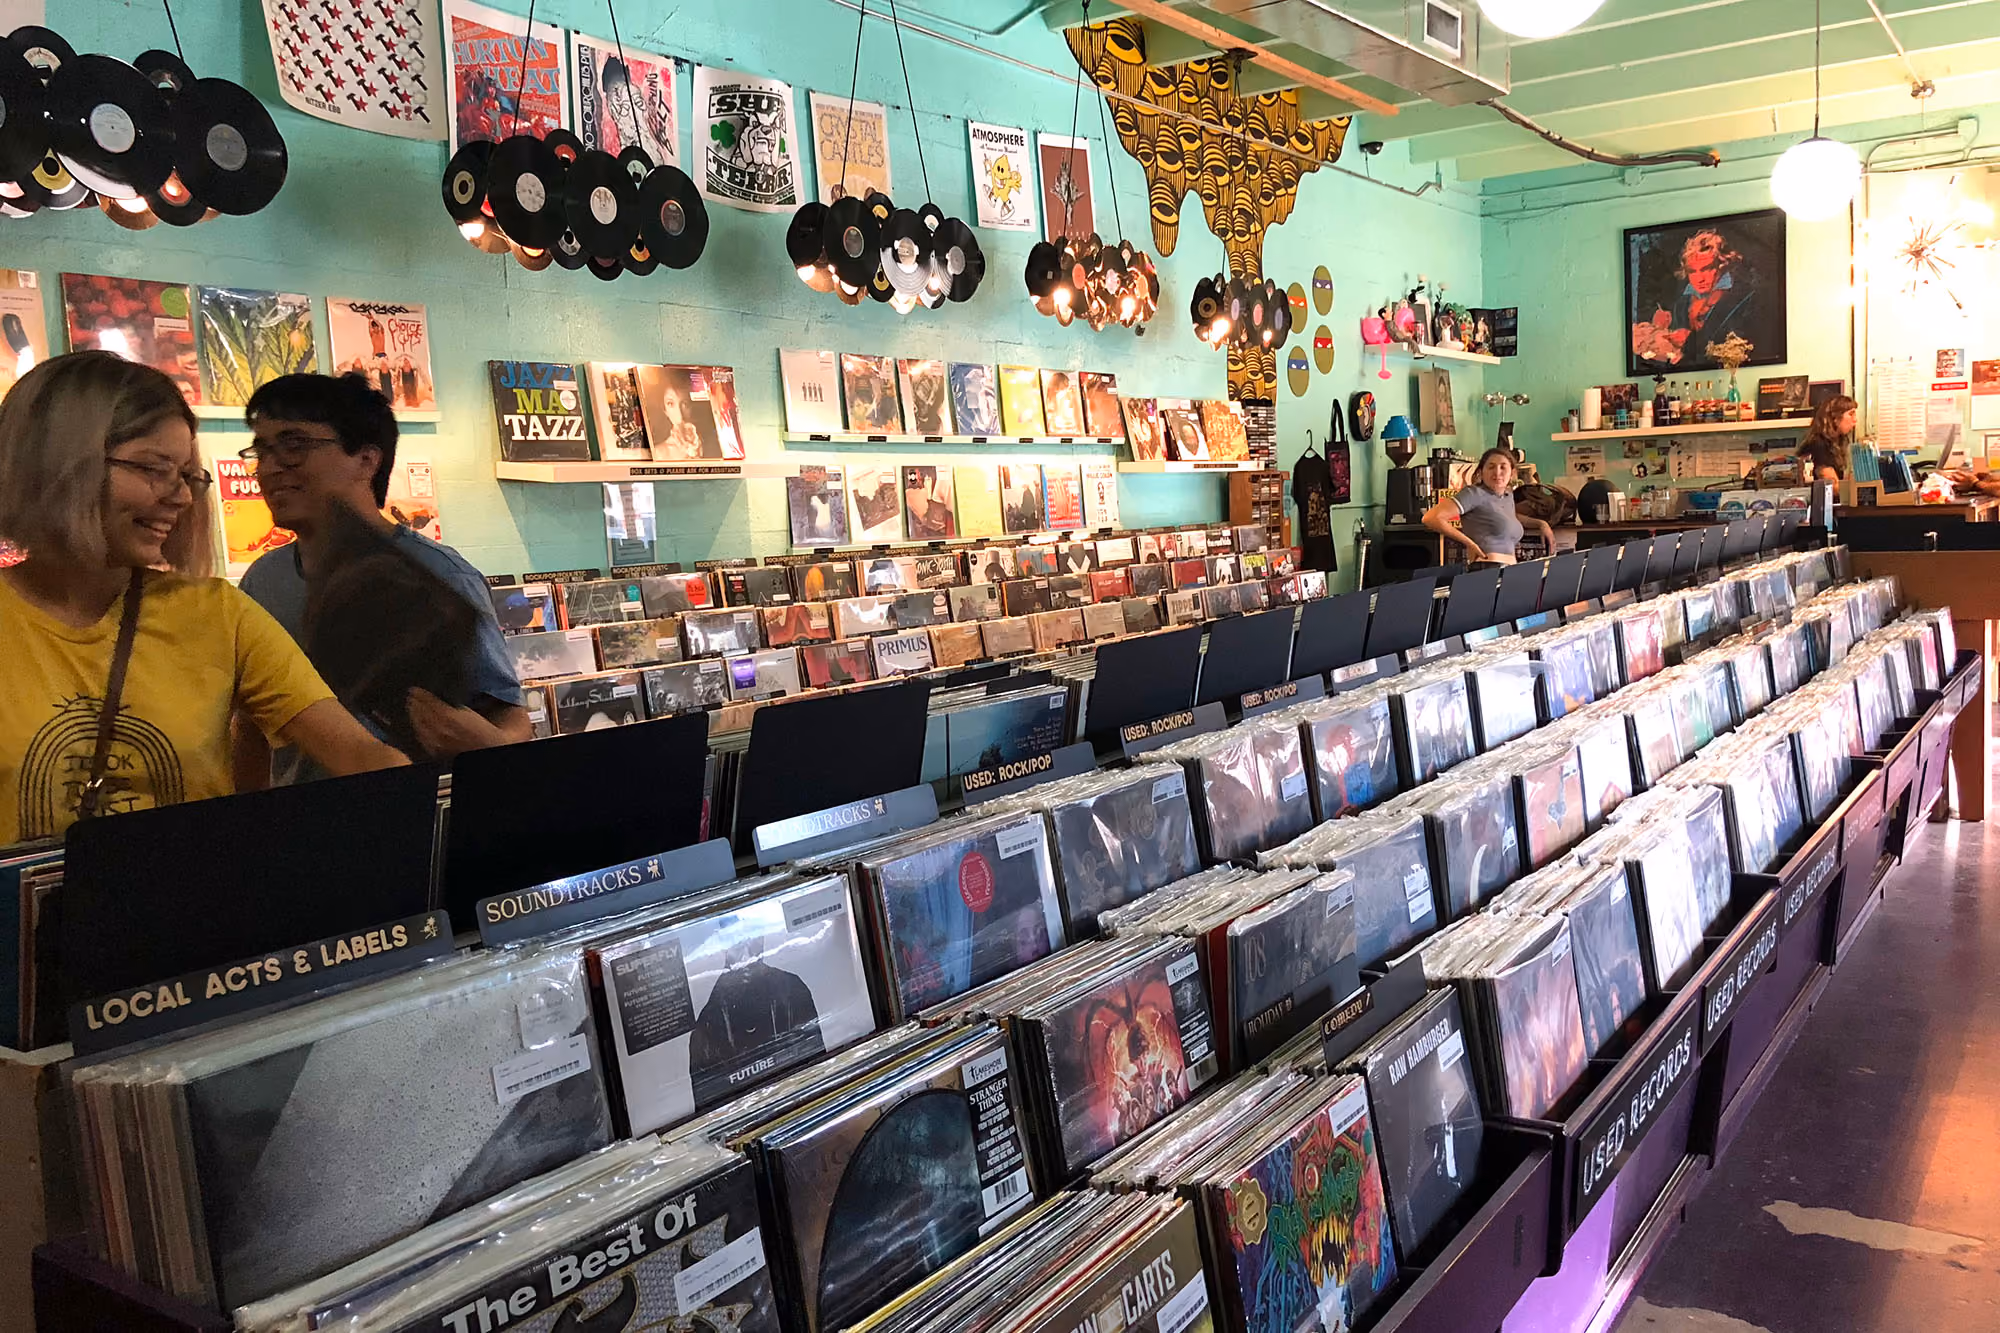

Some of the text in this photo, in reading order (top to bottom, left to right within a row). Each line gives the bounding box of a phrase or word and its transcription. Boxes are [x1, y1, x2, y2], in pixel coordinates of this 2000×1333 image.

[453, 36, 550, 65] HORTON
[484, 67, 560, 95] HEAT
[972, 128, 1025, 147] ATMOSPHERE
[501, 361, 574, 389] JAZZ
[513, 388, 569, 415] MA
[504, 414, 586, 441] TAZZ
[710, 466, 741, 474] ASSISTANCE
[877, 636, 927, 657] PRIMUS
[1264, 683, 1298, 701] ROCK/POP
[1124, 712, 1194, 743] USED: ROCK/POP
[964, 754, 1052, 792] USED: ROCK/POP
[487, 865, 642, 923] SOUNDTRACKS
[1784, 846, 1836, 925] USED RECORDS
[86, 924, 408, 1030] LOCAL ACTS & LABELS
[1707, 918, 1776, 1031] USED RECORDS
[1324, 1000, 1363, 1035] COMEDY
[1388, 1017, 1450, 1086] RAW HAMBURGER
[728, 1056, 776, 1085] FUTURE
[969, 1077, 1008, 1106] STRANGER
[978, 1090, 1004, 1112] THINGS
[1583, 1026, 1692, 1196] USED RECORDS
[442, 1195, 697, 1333] The Best Of
[1121, 1249, 1176, 1326] CARTS
